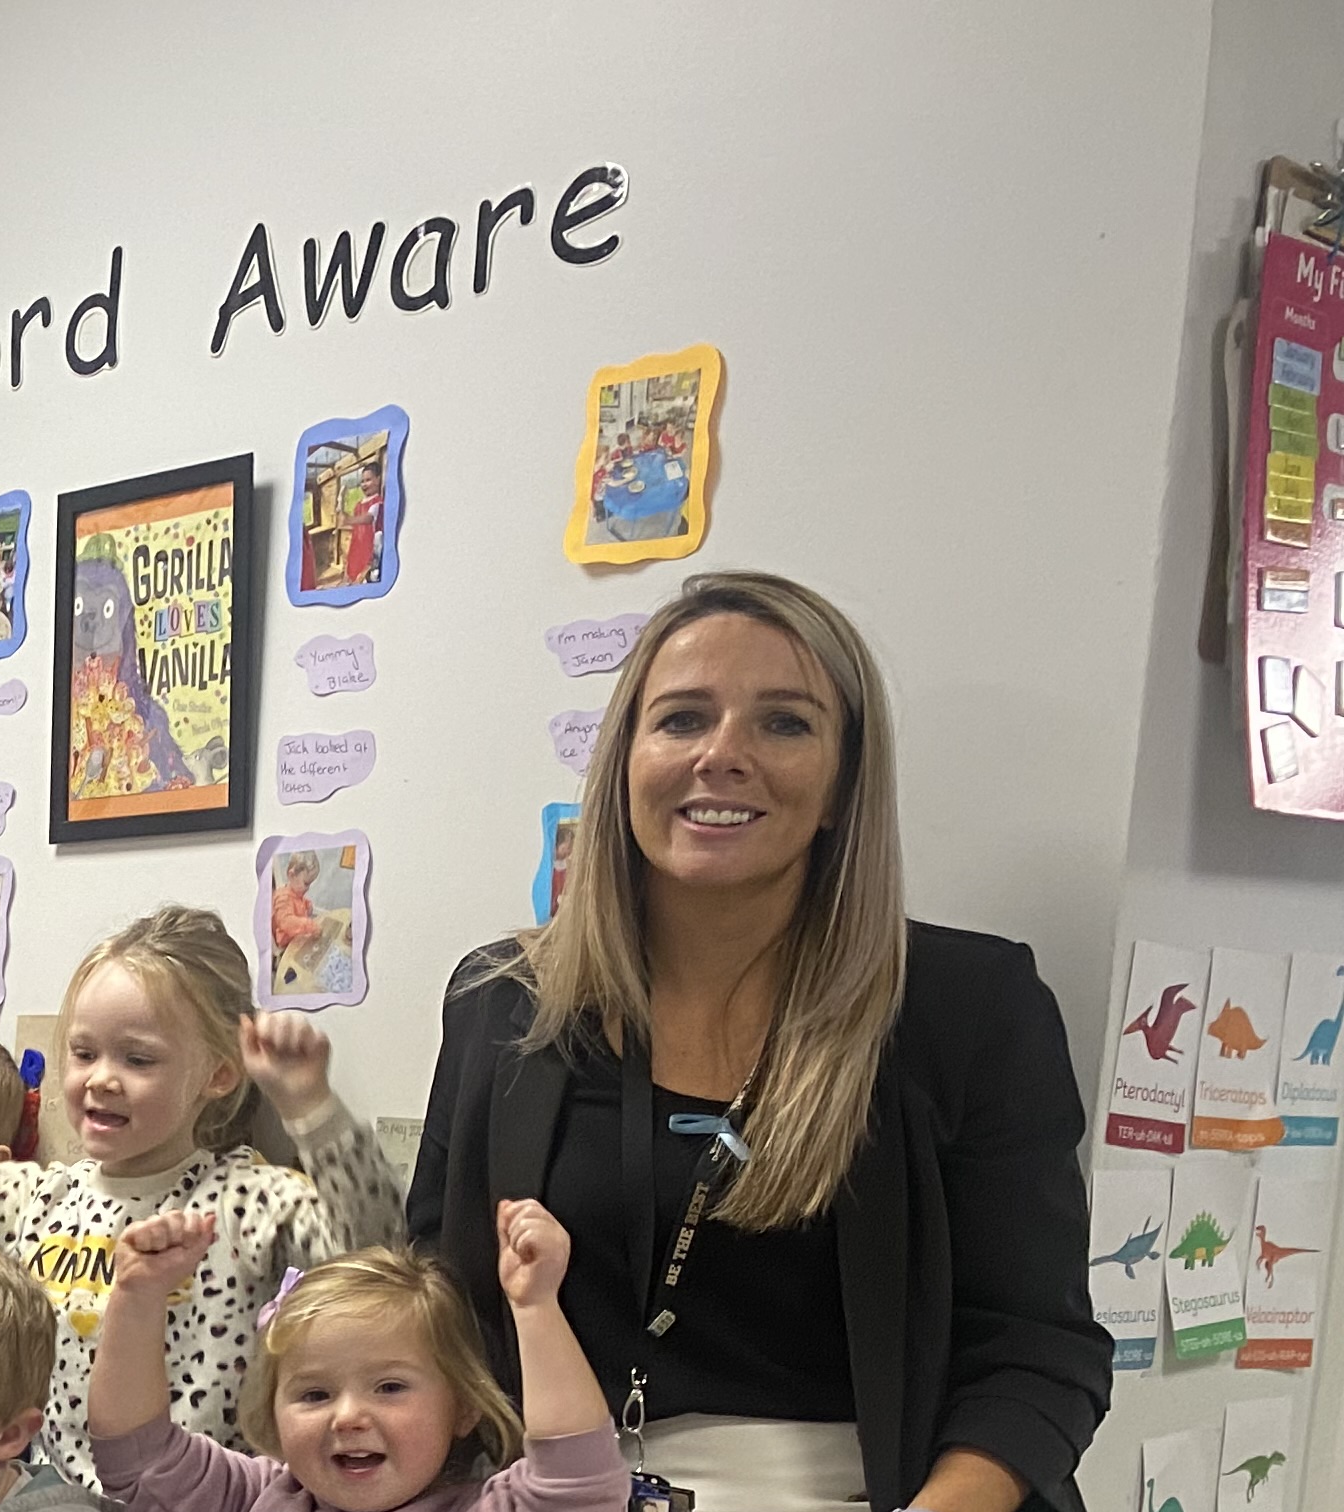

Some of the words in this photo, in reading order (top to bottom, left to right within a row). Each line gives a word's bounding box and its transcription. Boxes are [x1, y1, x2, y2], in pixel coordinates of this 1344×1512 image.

[211, 163, 629, 356] Aware
[1297, 252, 1324, 302] My
[158, 602, 221, 638] LOVES
[327, 671, 369, 690] Blake
[1115, 1078, 1185, 1113] Pterodactyl
[1200, 1081, 1267, 1109] Triceratops
[684, 1181, 710, 1226] BEST
[672, 1227, 695, 1260] THE
[665, 1264, 682, 1287] BE
[1172, 1290, 1240, 1317] Stegosaurus
